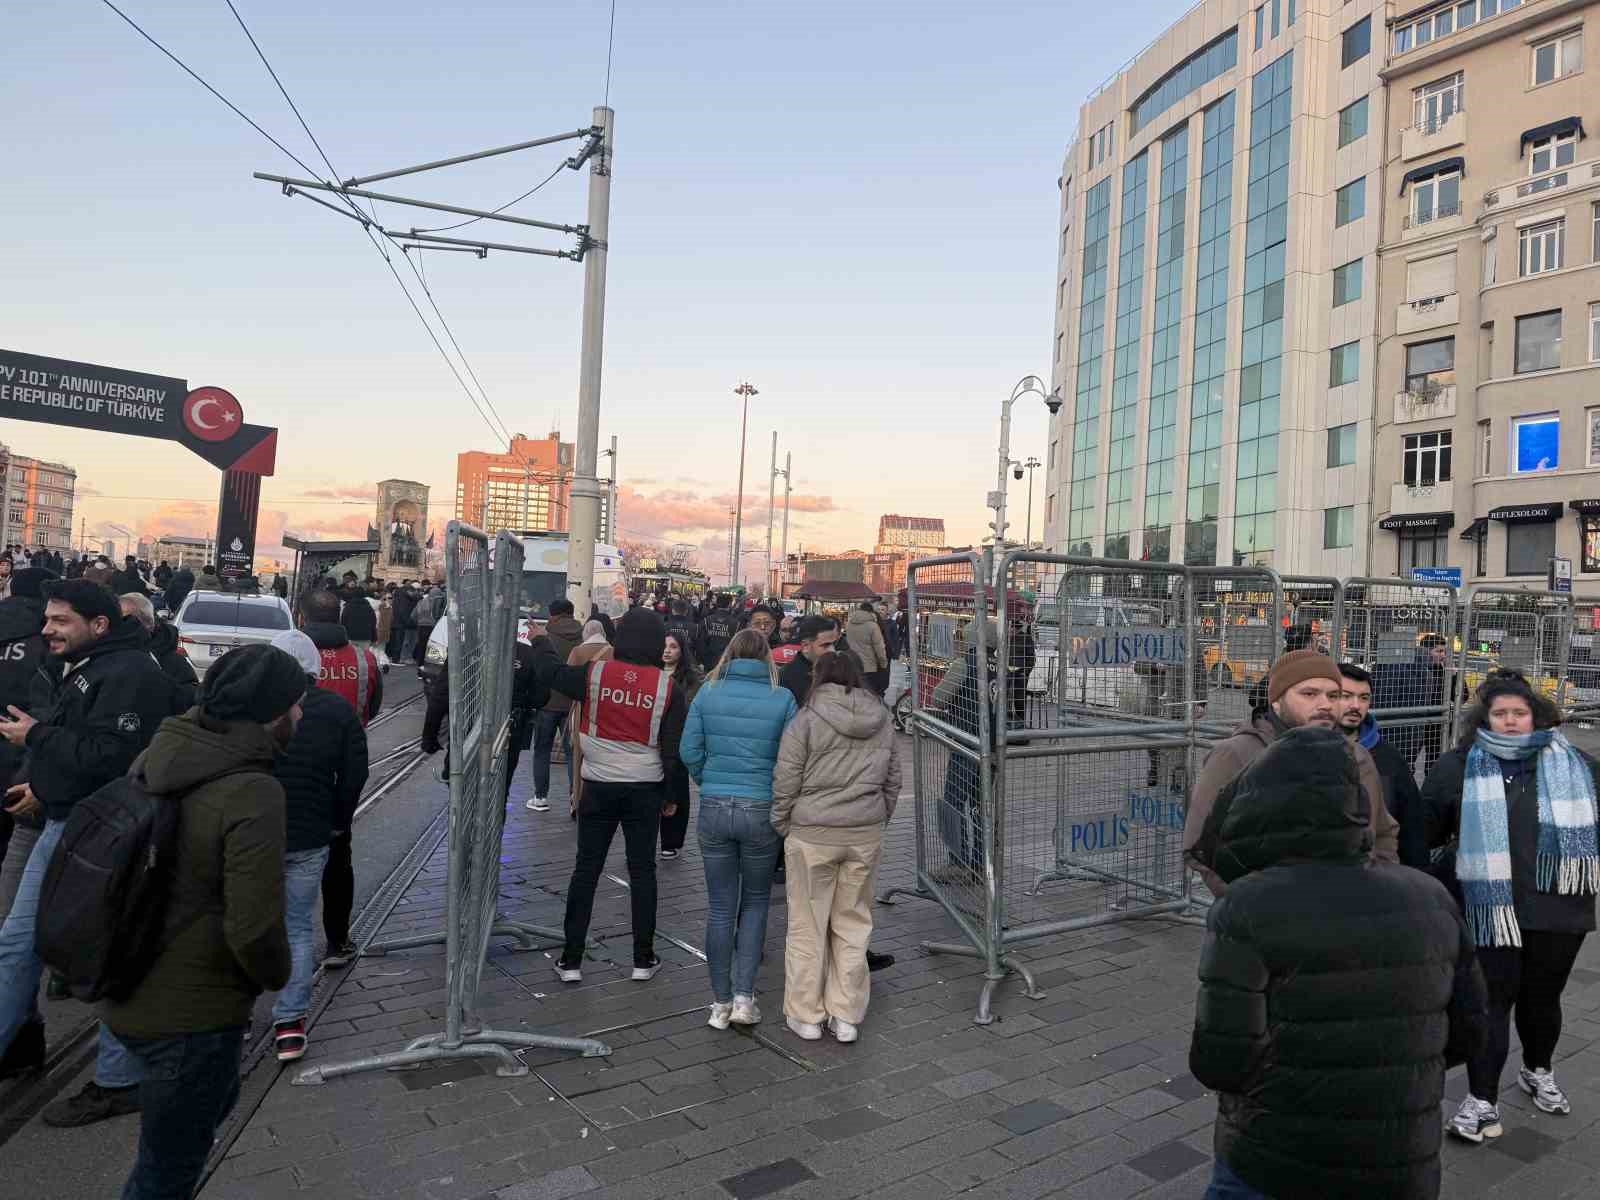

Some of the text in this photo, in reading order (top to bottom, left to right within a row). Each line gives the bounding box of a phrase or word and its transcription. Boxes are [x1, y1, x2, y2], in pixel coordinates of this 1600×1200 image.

[59, 375, 166, 404] ANNIVERSARY
[13, 386, 83, 411] REPUBLIC
[85, 397, 104, 413] OF
[104, 399, 165, 422] TÜRKİYE
[1383, 518, 1439, 529] FOOT MASSAGE
[1490, 508, 1549, 519] REFLEXOLOGY
[600, 687, 654, 709] POLİS
